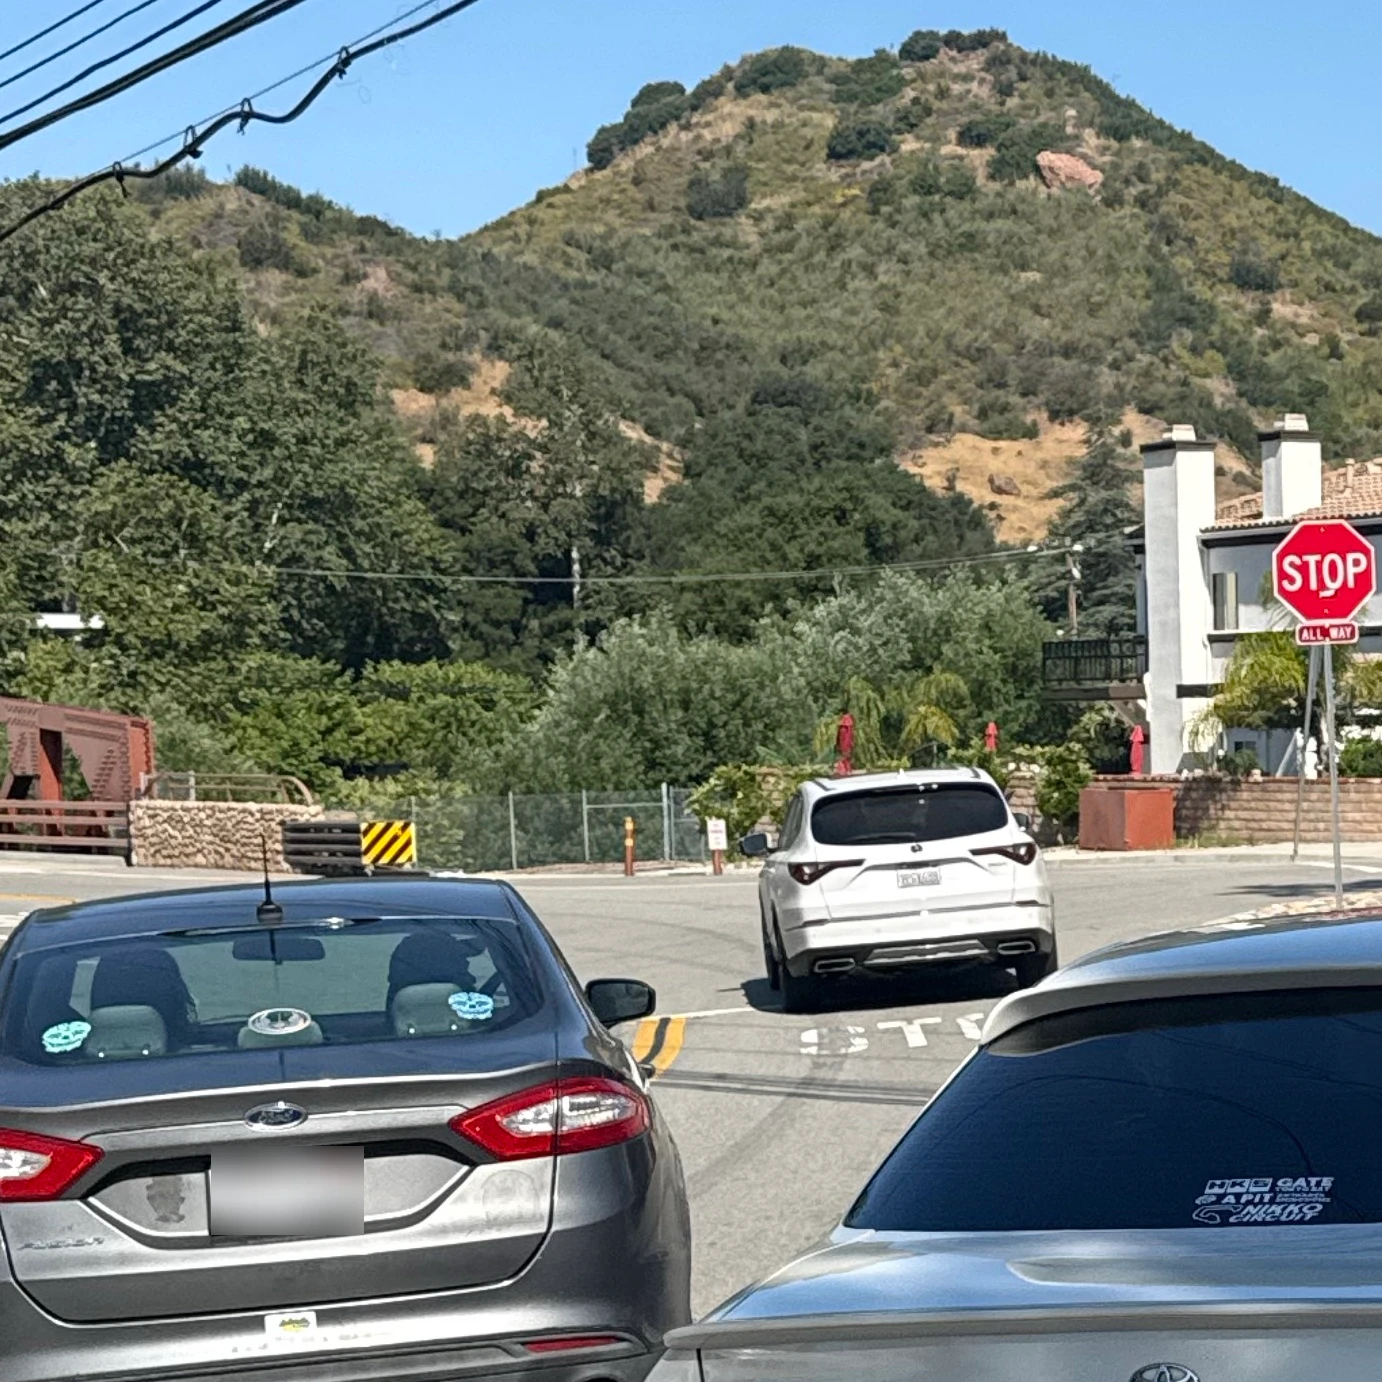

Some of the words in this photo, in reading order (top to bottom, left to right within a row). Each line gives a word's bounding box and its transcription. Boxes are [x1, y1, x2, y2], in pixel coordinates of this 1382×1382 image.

[1282, 551, 1368, 592] STOP
[1301, 627, 1324, 641] ALL
[1328, 626, 1353, 639] WAY
[1276, 1176, 1335, 1188] GATE
[1221, 1194, 1236, 1204] A
[1240, 1193, 1275, 1204] PIT
[1240, 1203, 1324, 1216] NIKKO
